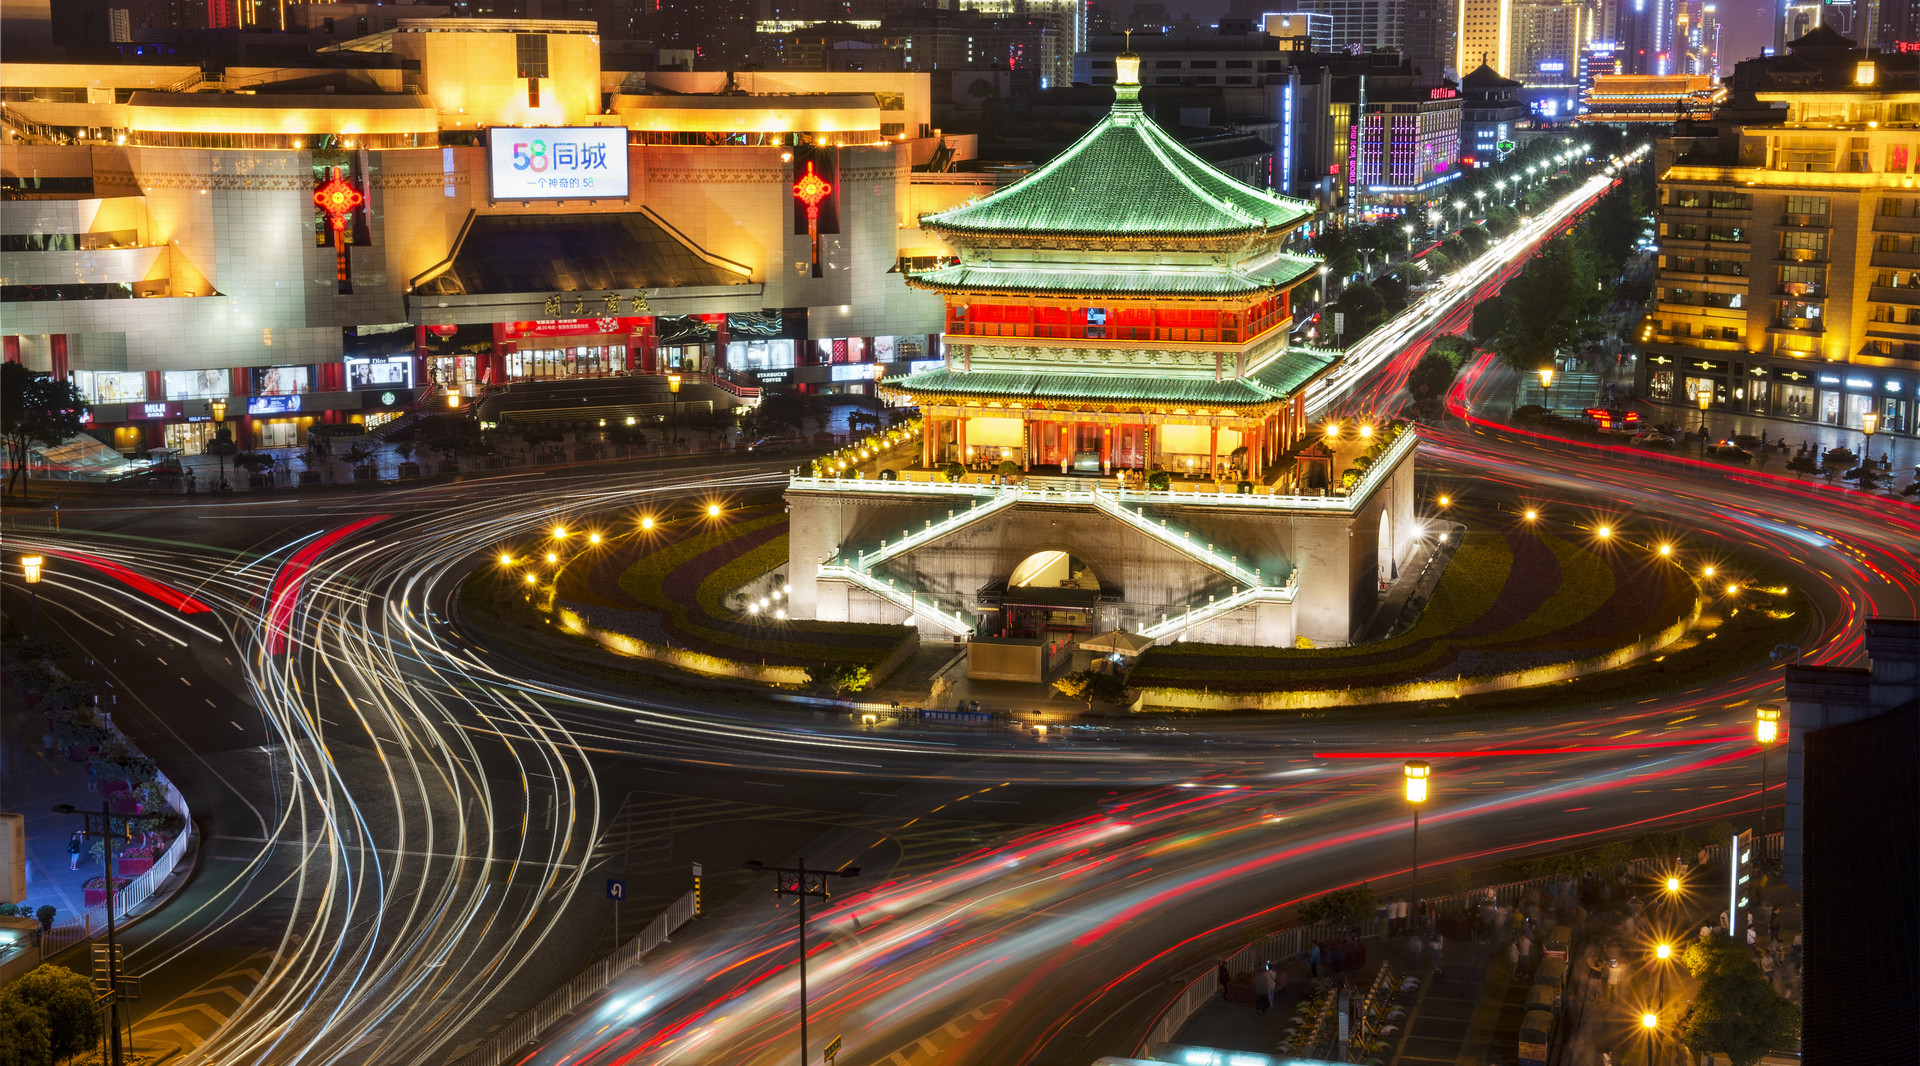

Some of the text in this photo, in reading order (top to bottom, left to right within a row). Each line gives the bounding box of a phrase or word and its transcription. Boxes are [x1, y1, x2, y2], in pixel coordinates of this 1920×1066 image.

[513, 139, 608, 173] 58同城
[1349, 160, 1357, 184] WORLD
[527, 177, 580, 189] 一个神奇的
[756, 371, 788, 379] STARBUCKS
[145, 403, 166, 413] MUJI
